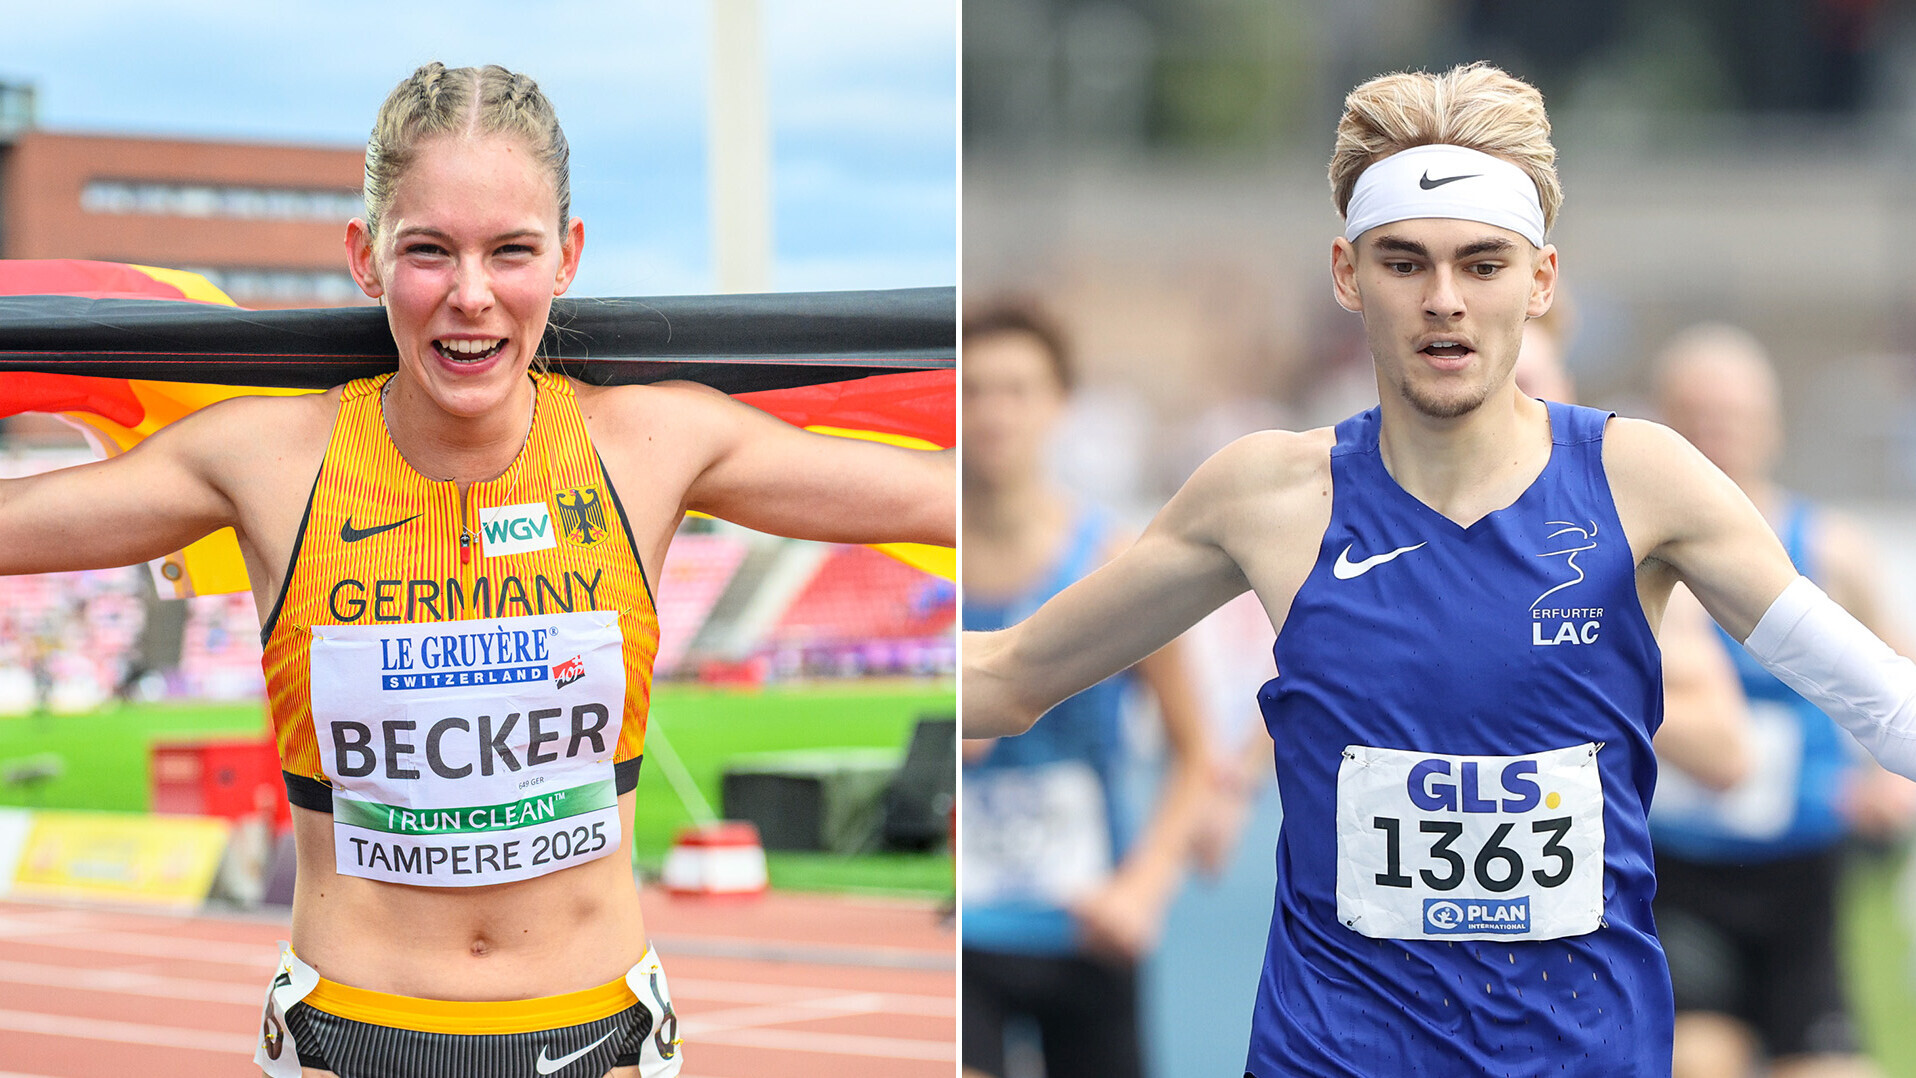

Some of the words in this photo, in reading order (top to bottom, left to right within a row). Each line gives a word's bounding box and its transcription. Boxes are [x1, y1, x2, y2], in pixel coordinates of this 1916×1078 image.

[482, 514, 548, 544] WGV
[329, 568, 603, 623] GERMANY
[1532, 607, 1604, 619] ERFURTER
[1532, 621, 1600, 646] LAC
[380, 638, 414, 671] LE
[389, 668, 542, 688] SWITZERLAND
[555, 665, 585, 684] AOP
[330, 702, 610, 780] BECKER
[518, 779, 530, 790] 649
[531, 777, 545, 786] GER
[388, 808, 395, 829] I
[401, 809, 461, 831] RUN
[350, 837, 522, 875] TAMPERE
[531, 821, 607, 866] 2025
[1373, 816, 1574, 892] 1363
[1468, 904, 1526, 922] PLAN
[1468, 922, 1526, 930] INTERNATIONAL
